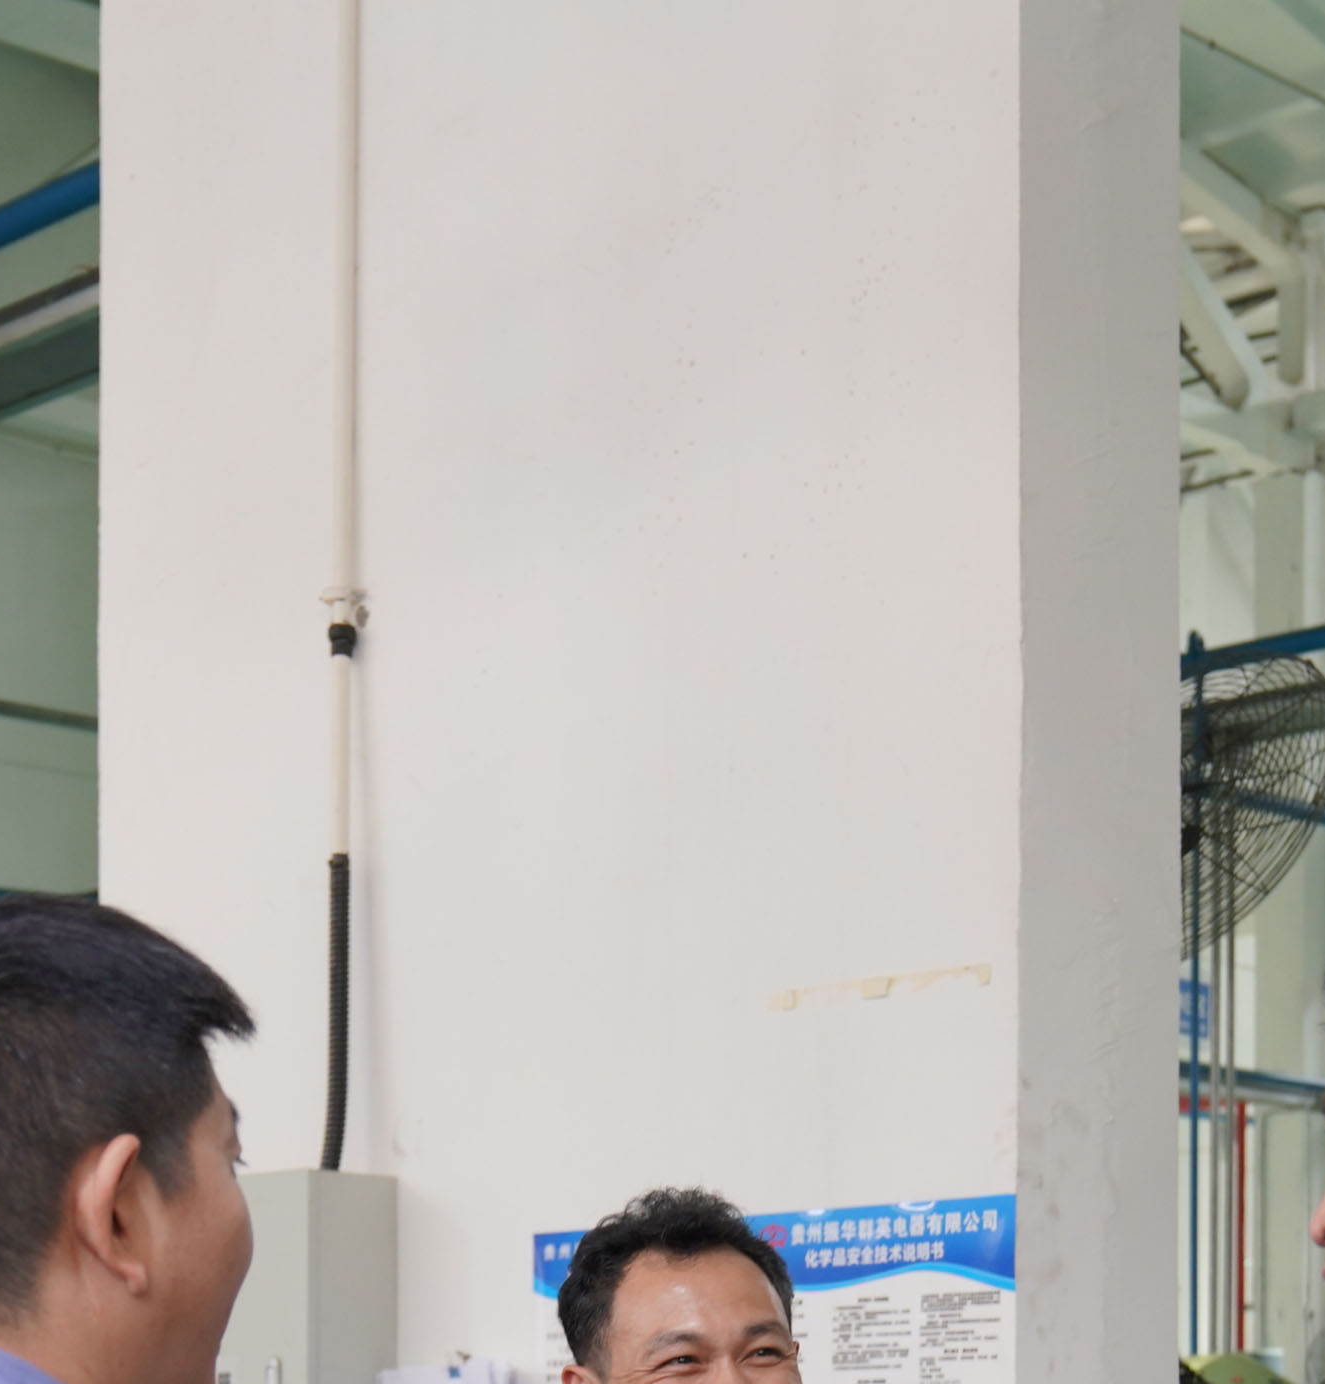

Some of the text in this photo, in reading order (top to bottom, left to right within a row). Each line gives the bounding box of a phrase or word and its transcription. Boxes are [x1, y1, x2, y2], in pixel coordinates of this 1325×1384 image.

[790, 1209, 998, 1246] 贵州振华群英电器有限公司
[804, 1241, 945, 1269] 化学品安全技术说明书
